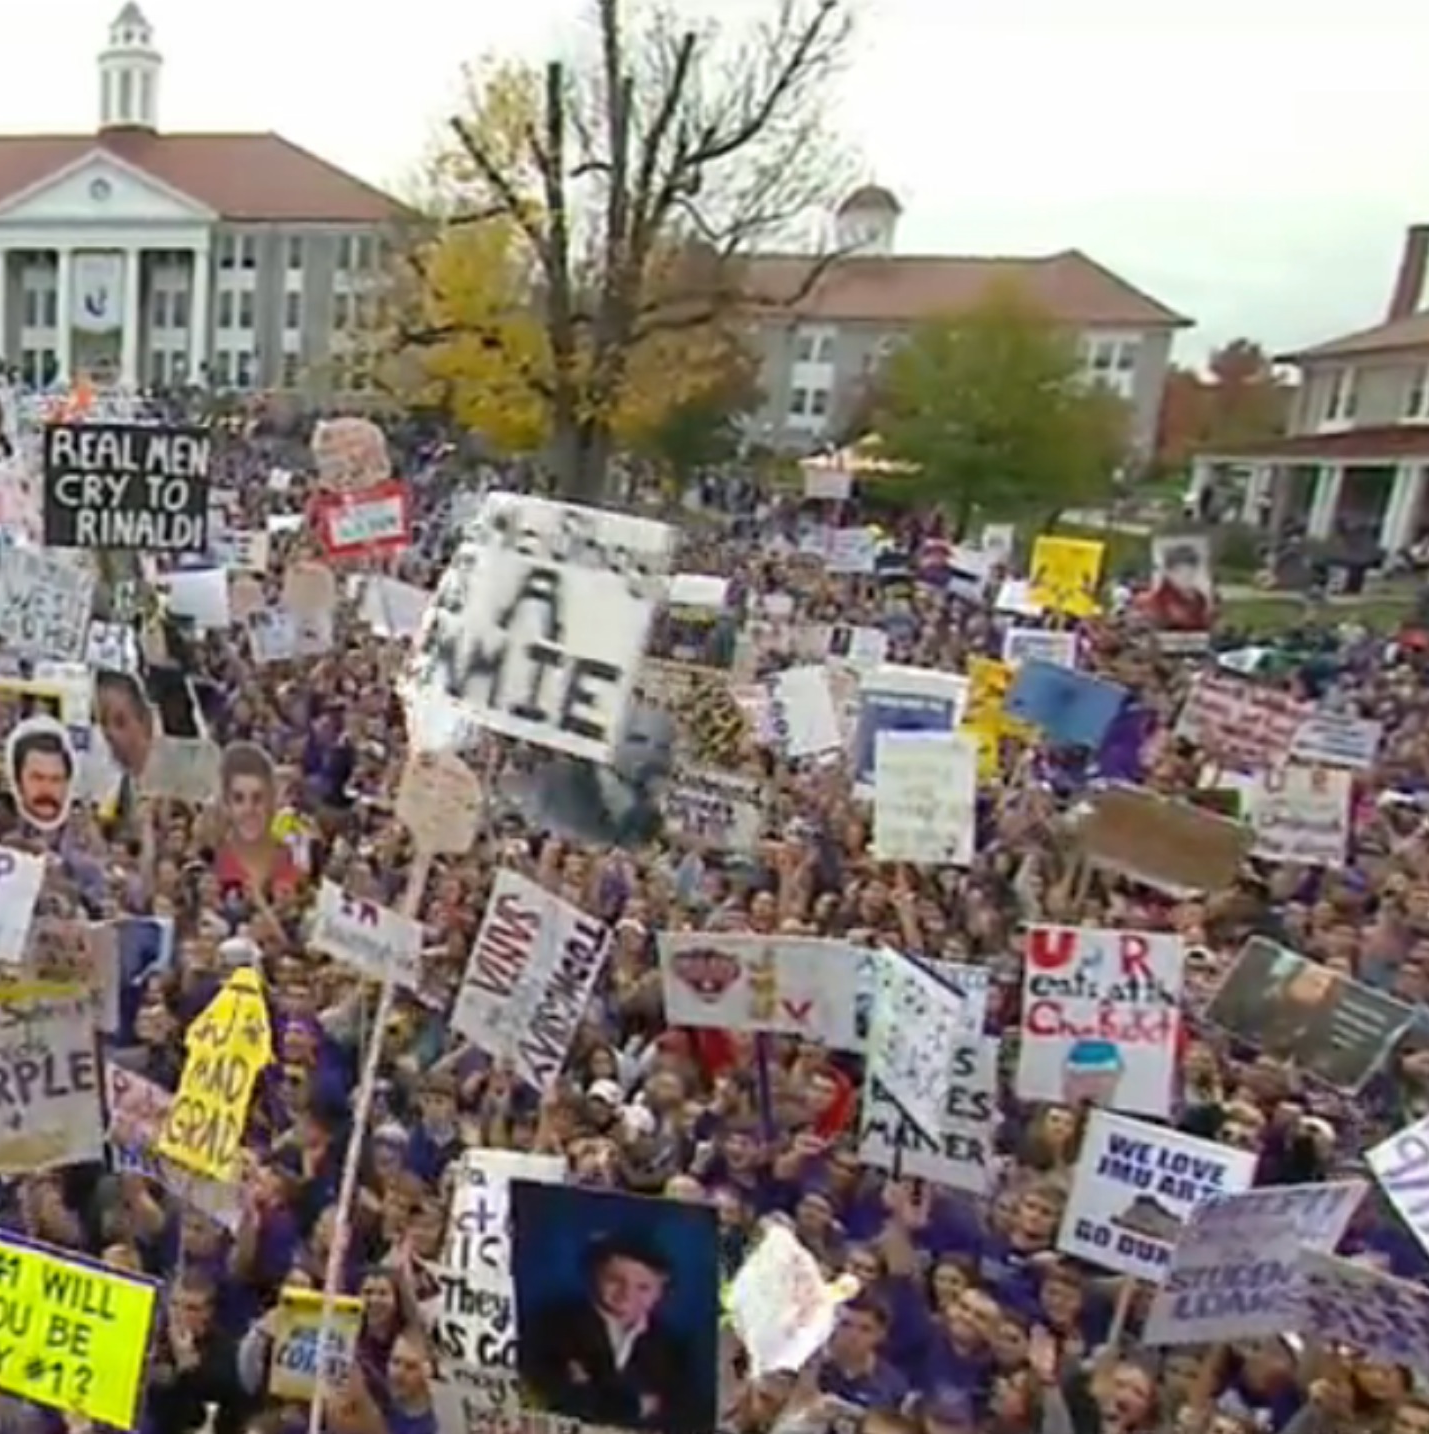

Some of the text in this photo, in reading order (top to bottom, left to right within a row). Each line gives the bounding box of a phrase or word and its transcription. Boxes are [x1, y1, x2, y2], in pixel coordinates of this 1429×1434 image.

[51, 427, 211, 477] REAL MEN
[54, 472, 190, 512] CRY TO
[76, 508, 203, 548] RINALDI
[1096, 1155, 1154, 1190] JMU
[1107, 1132, 1229, 1186] WE LOVE
[1073, 1217, 1112, 1248] GO
[40, 1262, 118, 1322] WILL
[45, 1314, 93, 1357] BE
